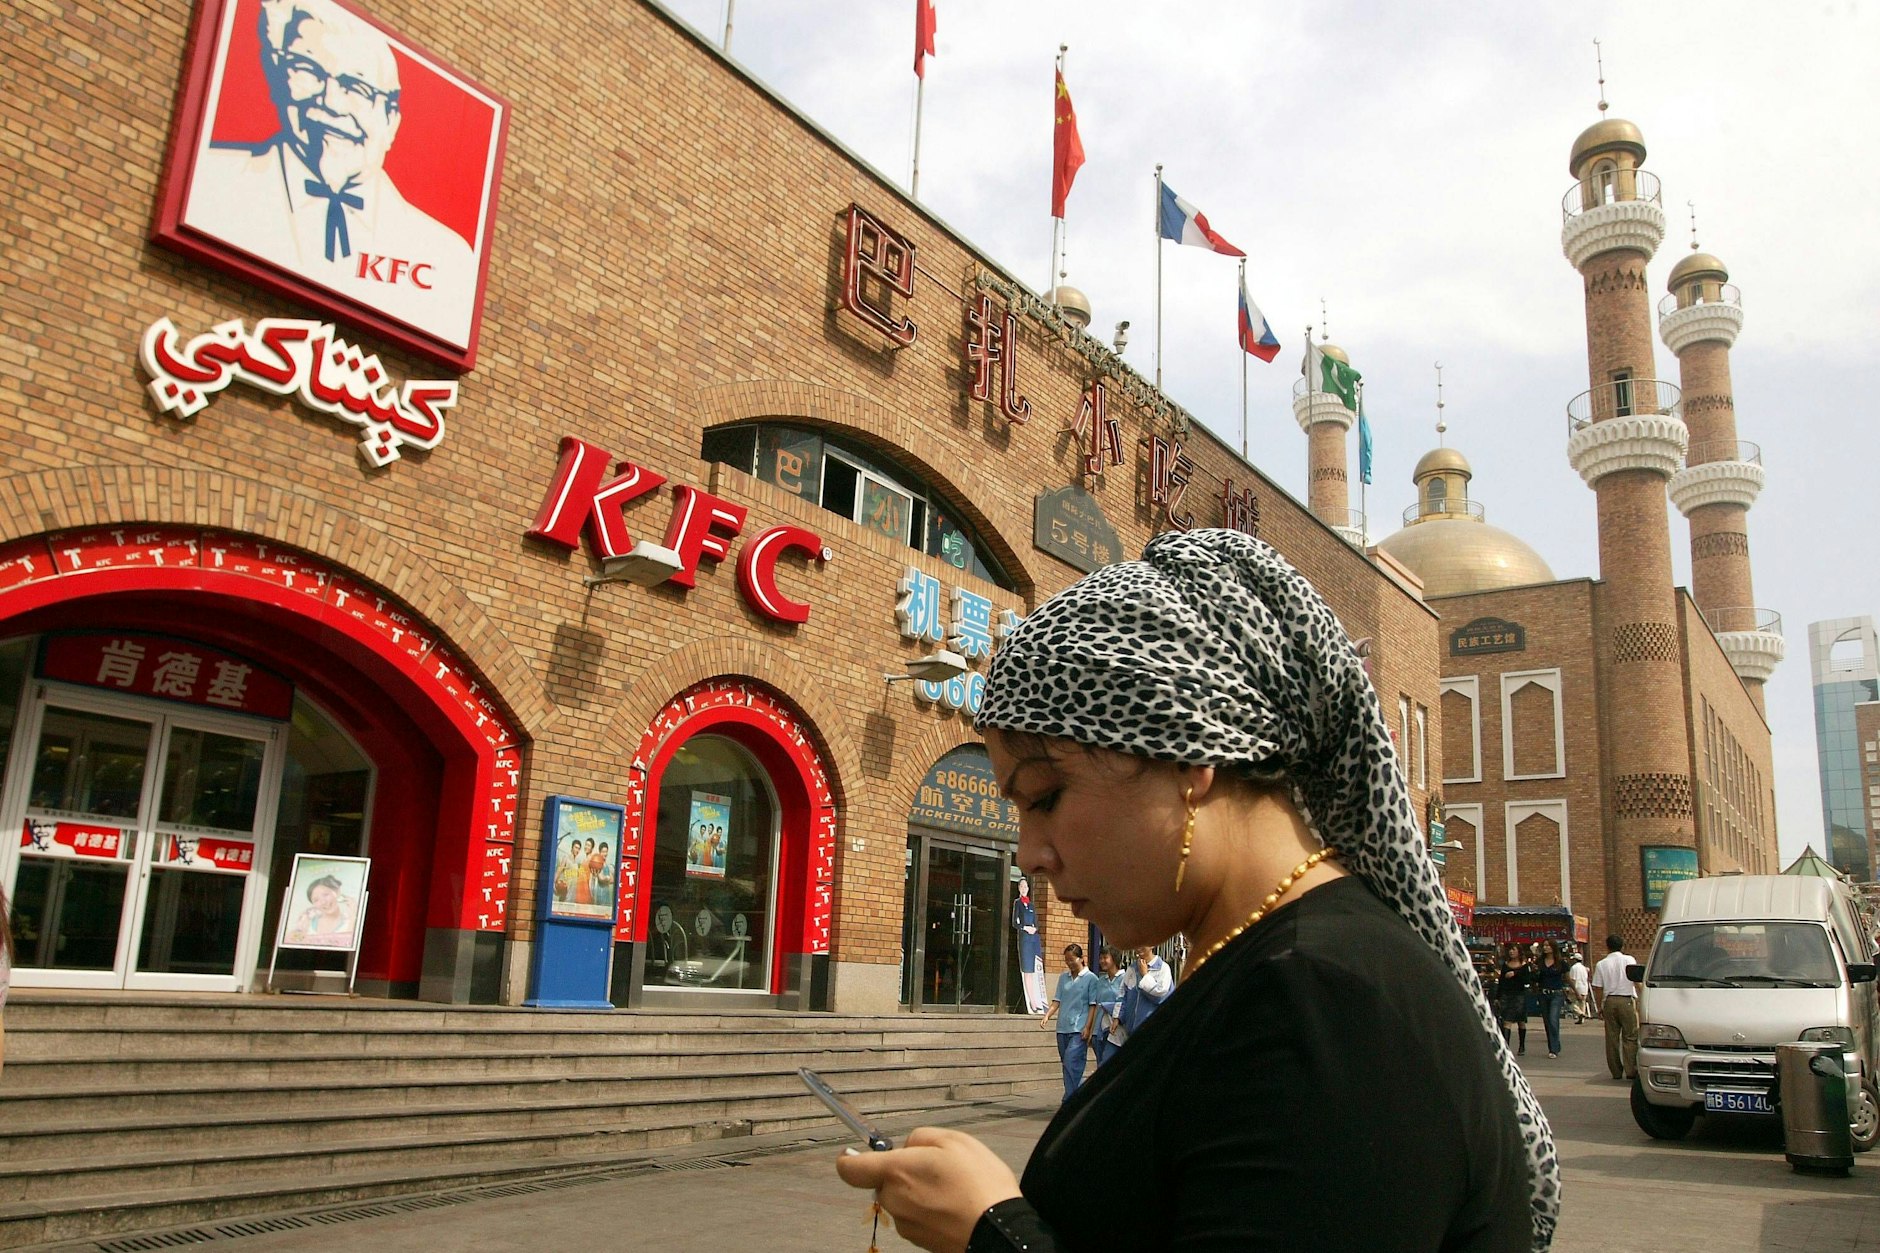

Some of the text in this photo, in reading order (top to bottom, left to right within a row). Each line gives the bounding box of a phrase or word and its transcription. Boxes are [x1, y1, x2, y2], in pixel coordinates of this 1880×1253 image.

[355, 252, 433, 290] KFC
[136, 532, 161, 544] KFC
[275, 554, 298, 565] KFC
[389, 611, 411, 626] KFC
[97, 640, 252, 707] 肯德基
[495, 760, 514, 768] KFC
[947, 770, 1001, 799] 86666
[912, 806, 983, 827] TICKETING
[74, 832, 118, 850] 肯德基
[485, 848, 505, 858] KFC
